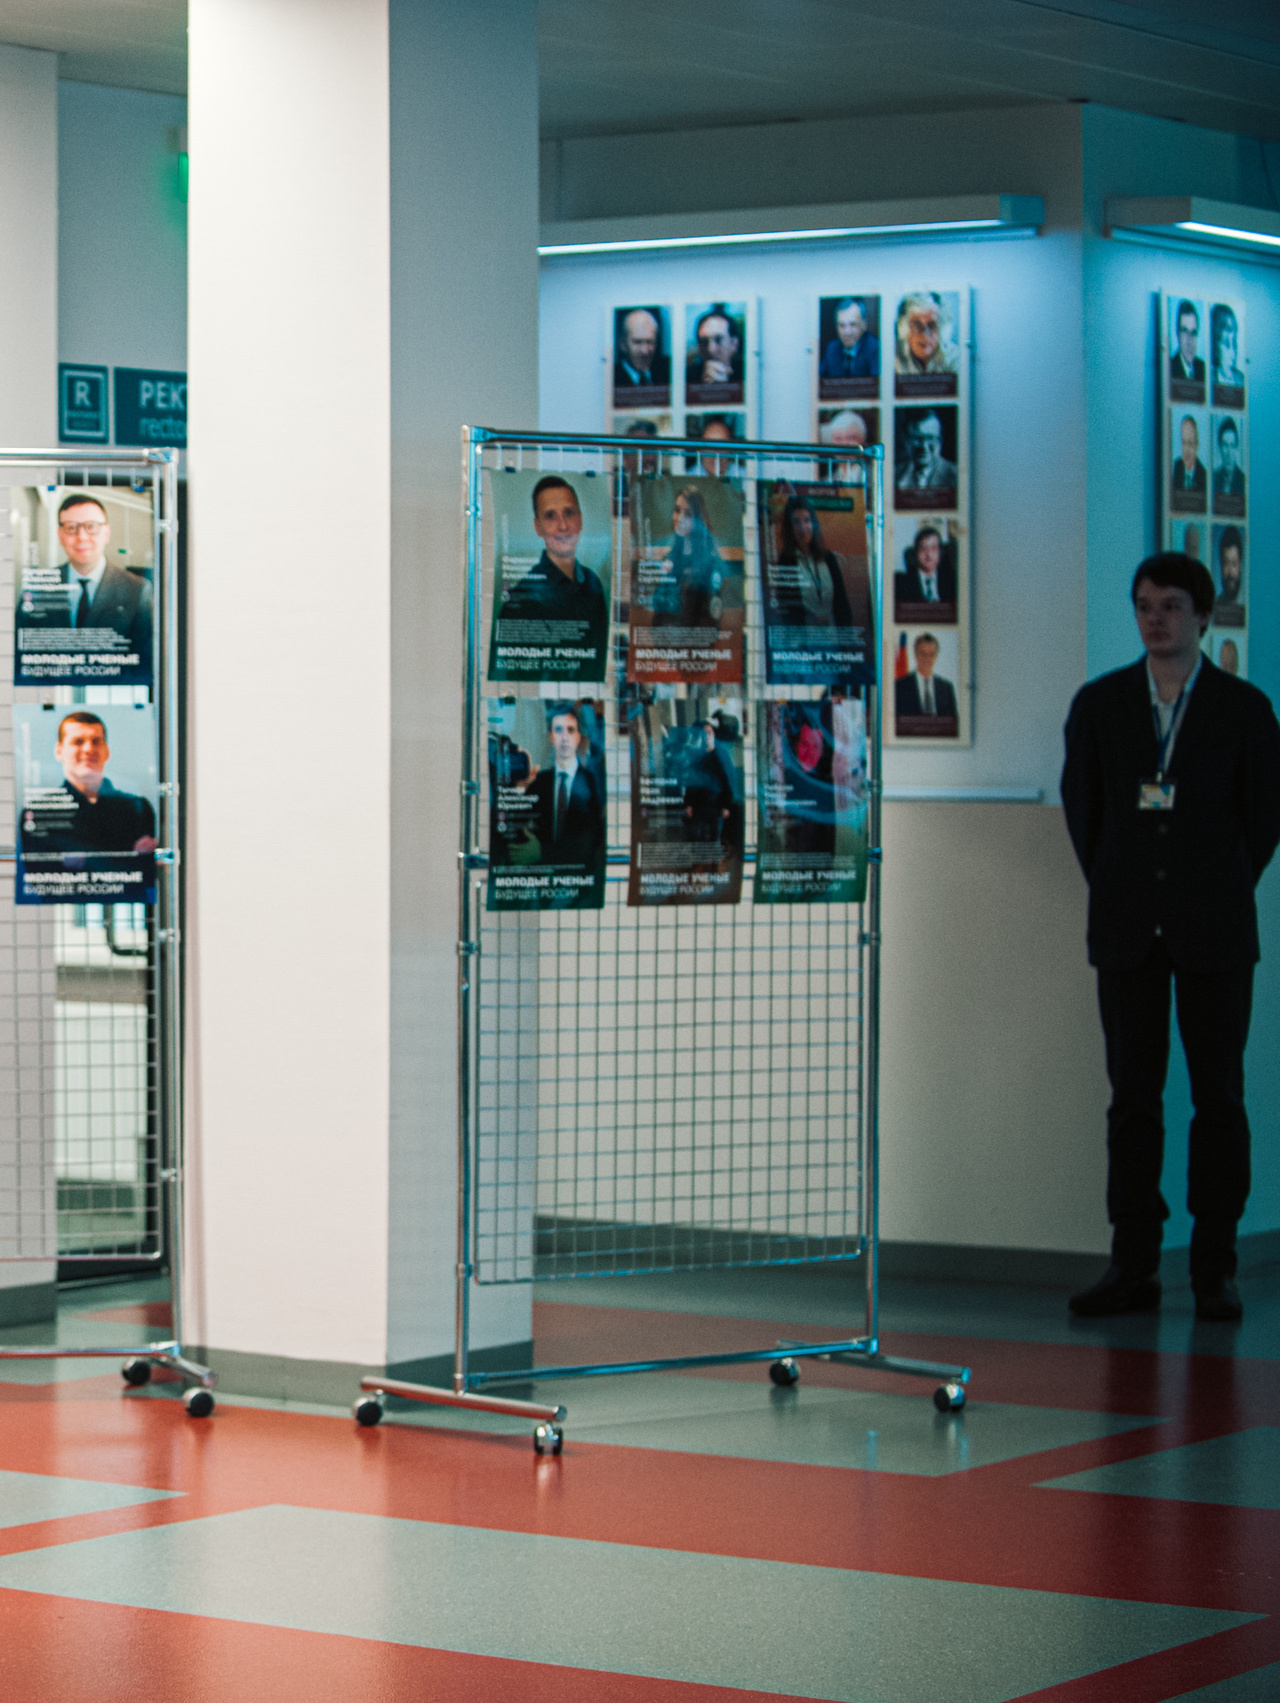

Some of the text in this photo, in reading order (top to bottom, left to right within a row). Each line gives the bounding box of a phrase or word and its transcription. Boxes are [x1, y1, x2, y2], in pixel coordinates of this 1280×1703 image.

[75, 381, 92, 407] R
[141, 380, 186, 410] РЕК
[22, 654, 140, 665] МОЛОДЫЕ УЧЕНЫЕ
[24, 871, 143, 884] МОЛОДЫЕ УЧЕНЫЕ
